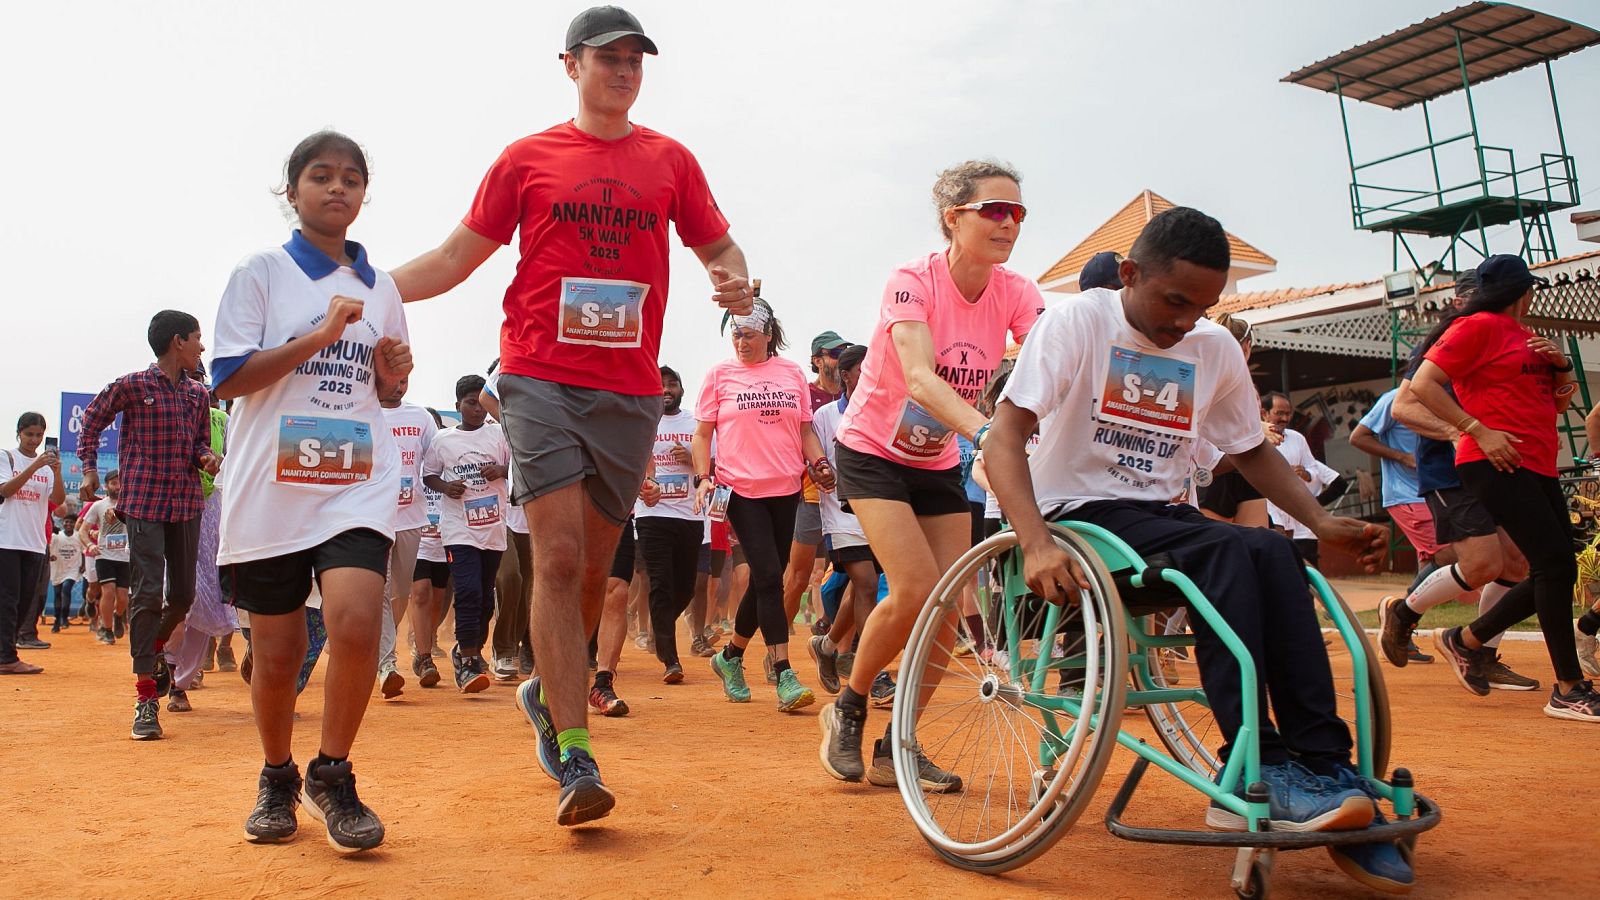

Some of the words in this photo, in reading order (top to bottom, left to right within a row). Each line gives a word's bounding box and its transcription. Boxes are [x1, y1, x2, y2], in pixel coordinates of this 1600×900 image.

[552, 202, 658, 232] ANANTAPUR
[579, 226, 594, 241] 5K
[598, 229, 631, 246] WALK
[590, 245, 620, 260] 2025
[895, 291, 910, 304] 10
[581, 302, 626, 329] S-1
[566, 327, 598, 337] ANANTAPUR
[960, 351, 968, 365] X
[295, 361, 354, 379] RUNNING
[355, 367, 371, 386] DAY
[935, 364, 994, 387] ANTAPU
[318, 380, 353, 396] 2025
[1122, 373, 1179, 411] S-4
[738, 400, 797, 410] ULTRAMARATHON
[1105, 400, 1140, 414] ANANTAPUR
[1140, 408, 1176, 422] COMMUNITY
[655, 433, 694, 442] OLUNTEE
[1093, 427, 1156, 455] RUNNING
[298, 438, 354, 470] S-1
[453, 461, 497, 475] COMMU
[1117, 453, 1153, 473] 2025
[281, 468, 320, 478] ANANTAPUR
[320, 471, 354, 480] COMMUNITY
[659, 482, 688, 494] AA-4
[468, 504, 499, 520] AA-3
